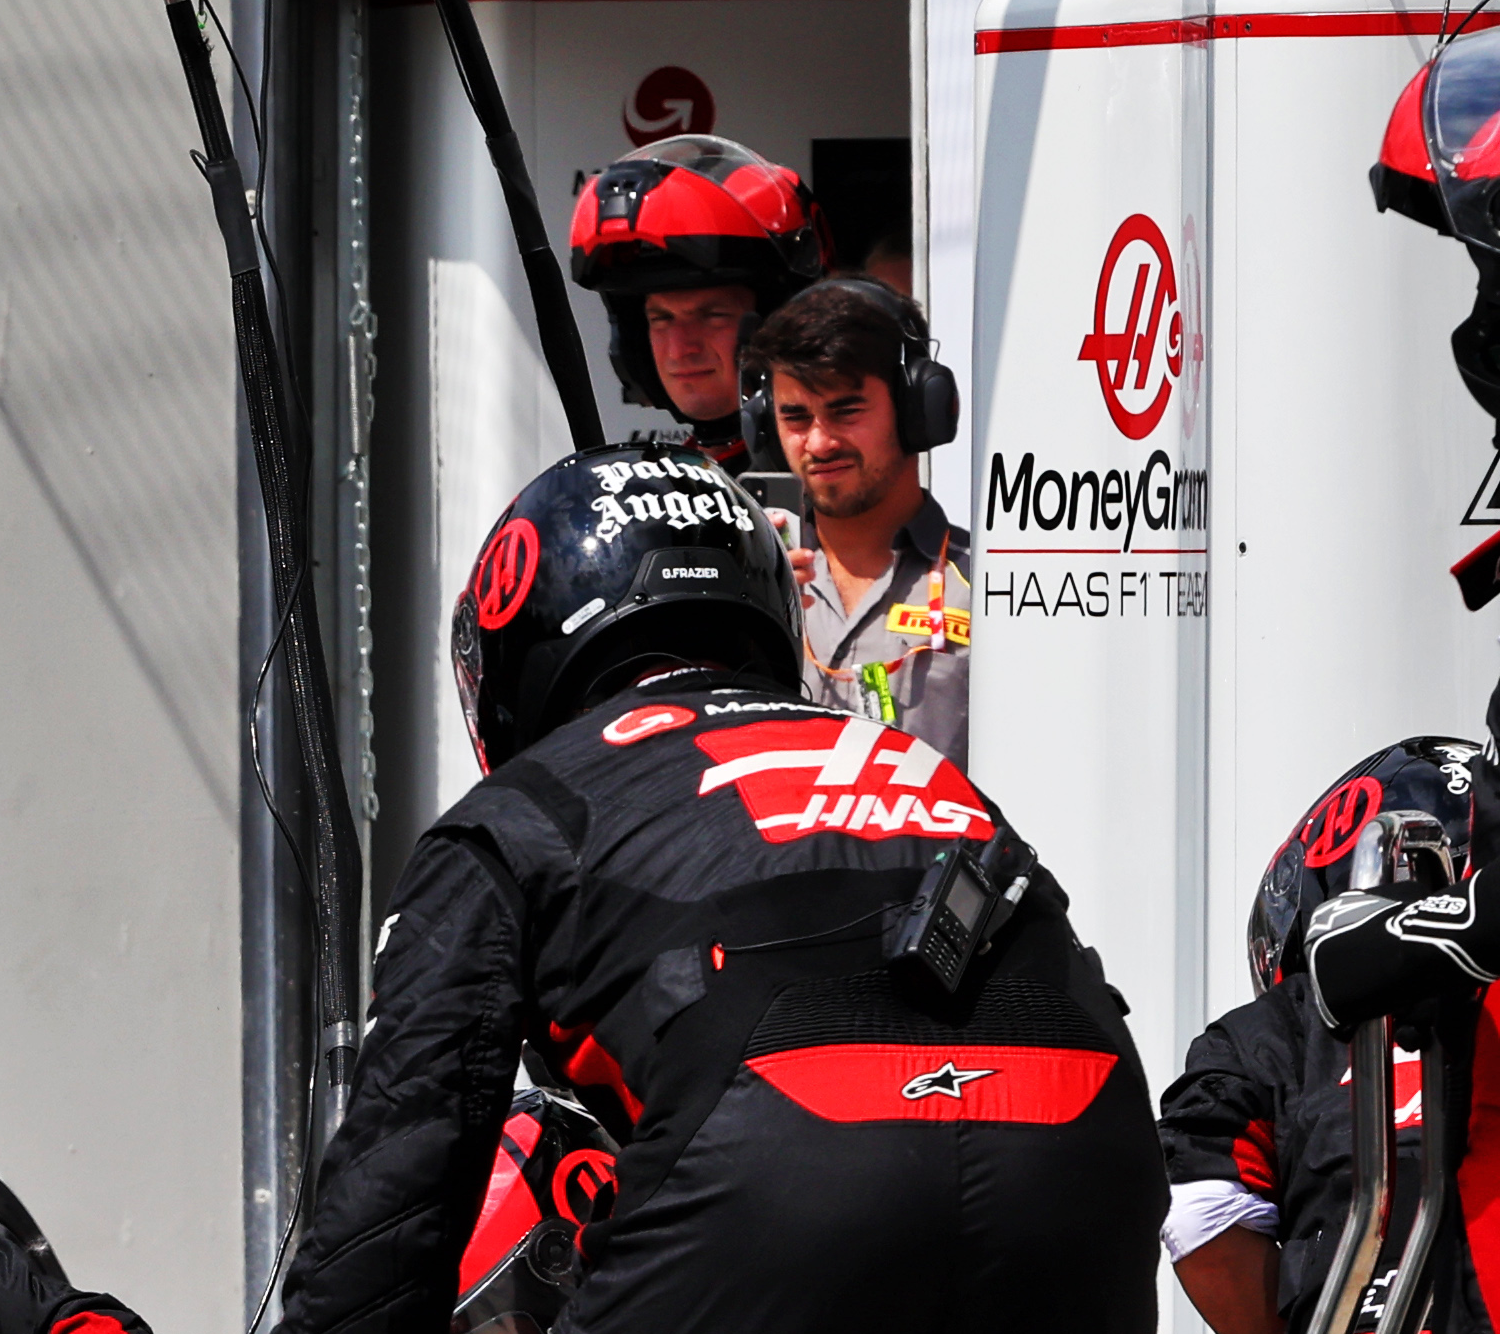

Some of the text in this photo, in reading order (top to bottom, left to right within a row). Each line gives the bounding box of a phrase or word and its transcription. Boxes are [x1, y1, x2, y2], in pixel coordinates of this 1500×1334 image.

[591, 457, 728, 493] Palm
[591, 490, 755, 543] Angels
[986, 450, 1208, 554] MoneyGram
[662, 567, 719, 579] G.FRAZIER
[984, 571, 1110, 618] HAAS
[1120, 571, 1151, 618] F1
[756, 794, 990, 832] HAAS
